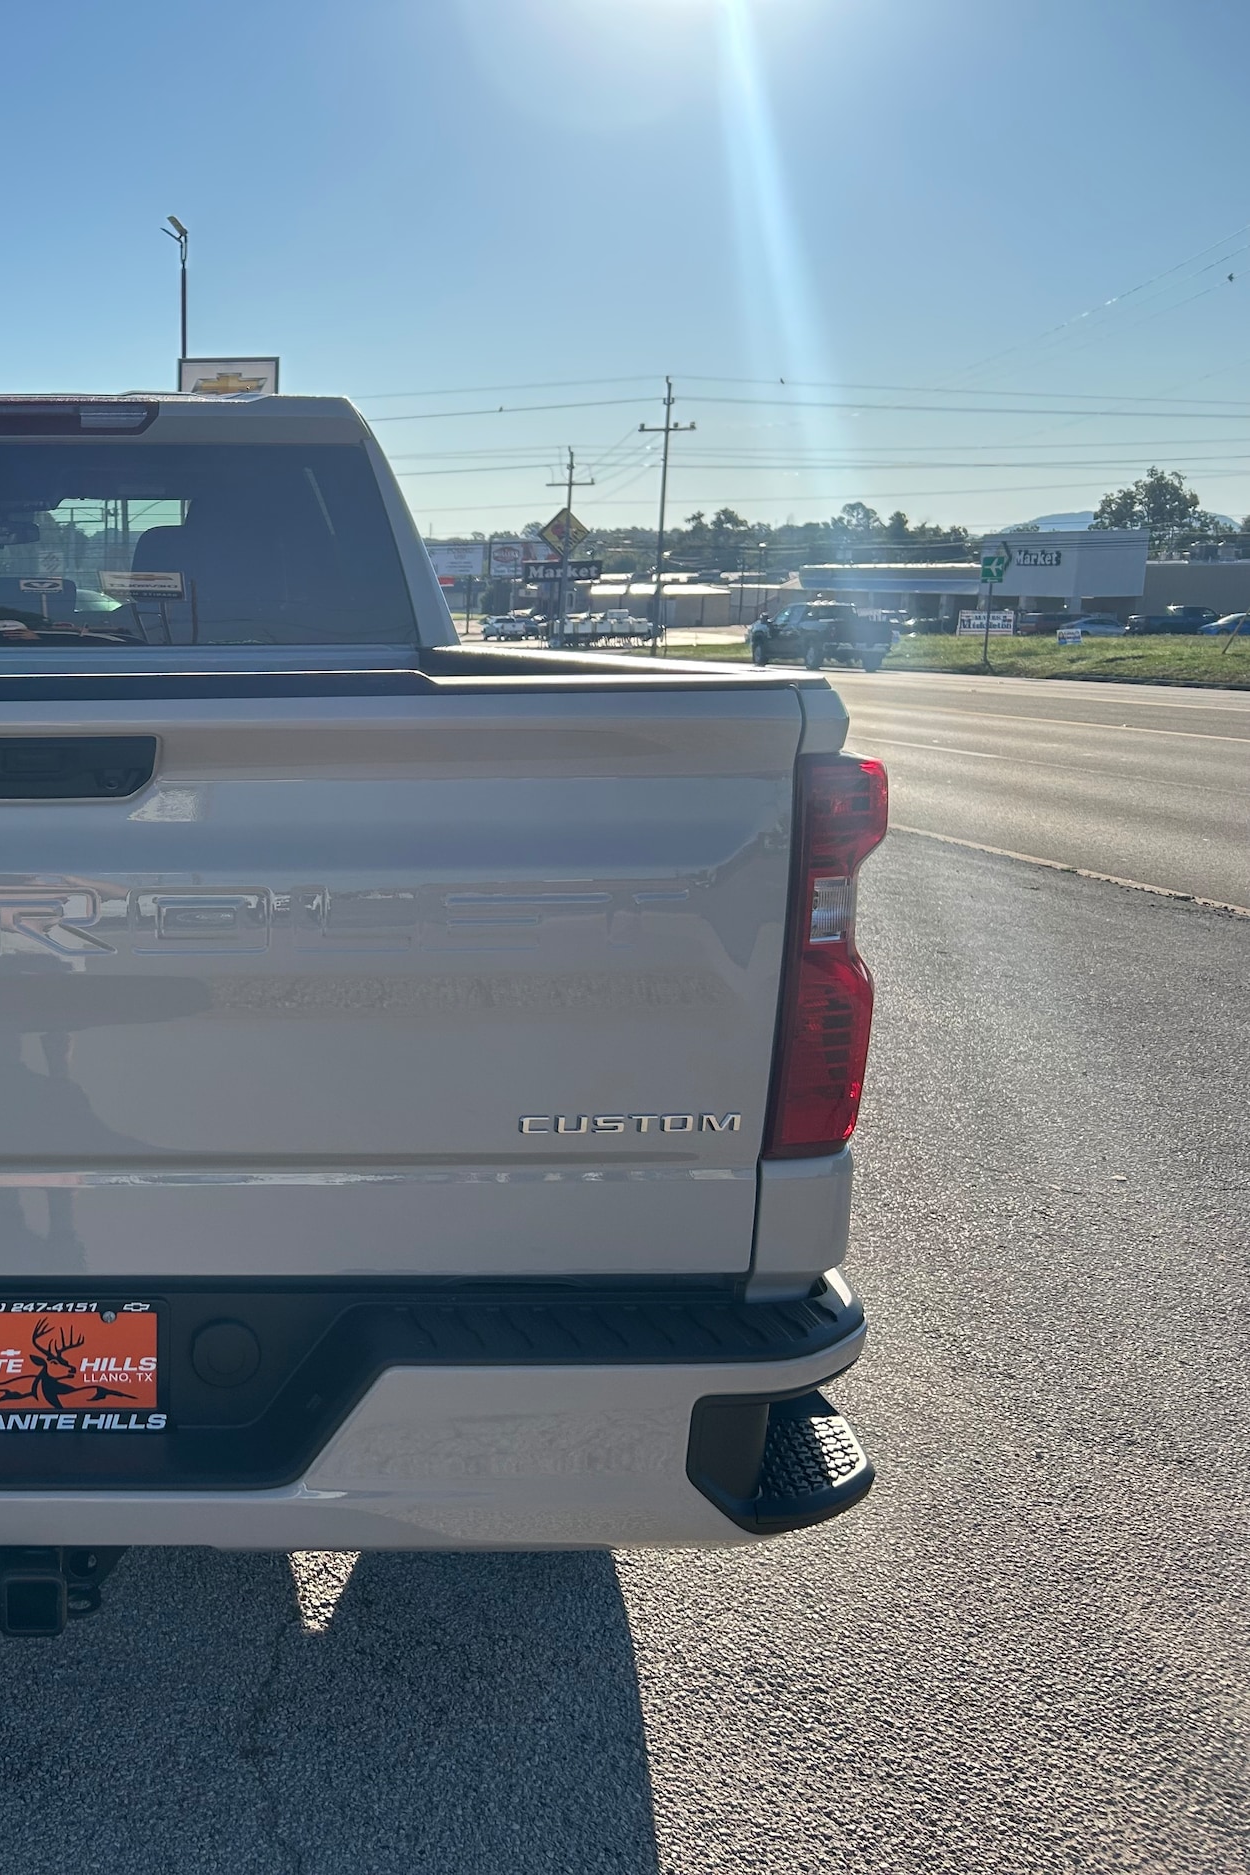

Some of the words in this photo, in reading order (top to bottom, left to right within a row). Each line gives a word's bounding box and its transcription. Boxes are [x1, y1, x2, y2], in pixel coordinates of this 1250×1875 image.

[1015, 550, 1061, 566] Market
[528, 565, 598, 578] Market
[519, 1112, 742, 1134] CUSTOM
[11, 1302, 98, 1313] 247-4151
[80, 1357, 157, 1372] HILLS
[83, 1372, 132, 1383] LLANO,
[137, 1372, 153, 1382] TX
[82, 1413, 167, 1430] HILLS
